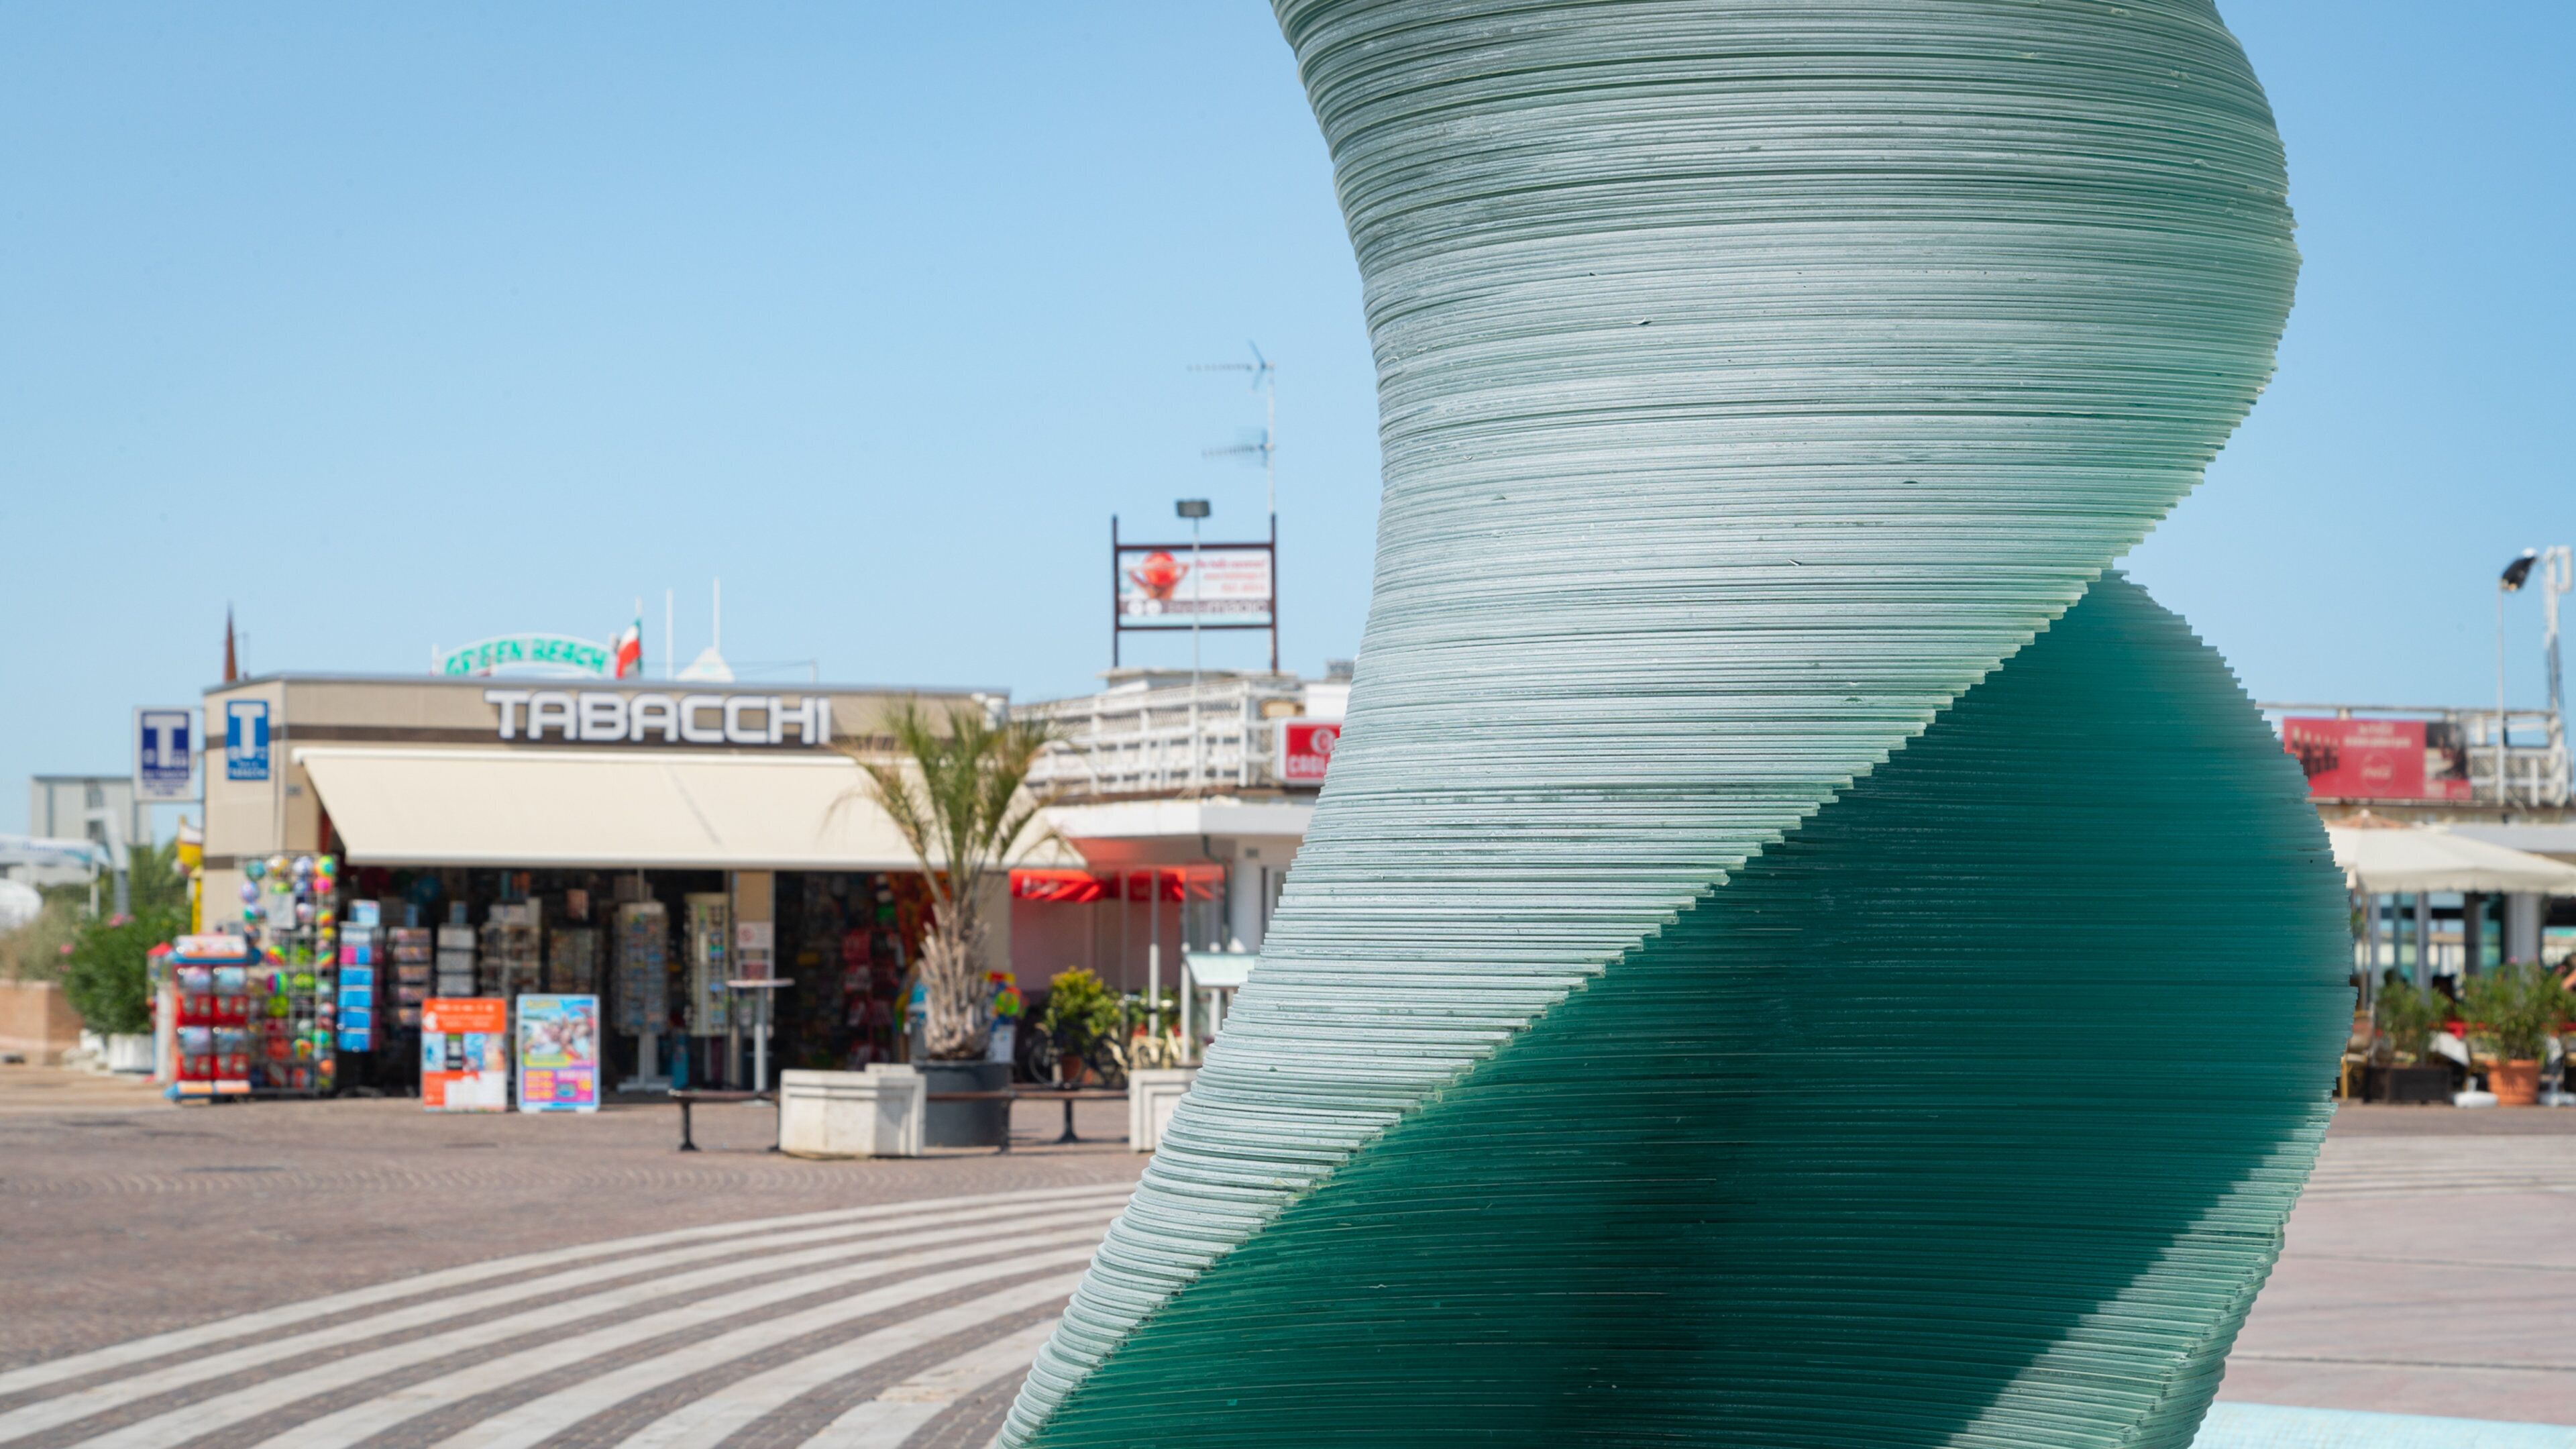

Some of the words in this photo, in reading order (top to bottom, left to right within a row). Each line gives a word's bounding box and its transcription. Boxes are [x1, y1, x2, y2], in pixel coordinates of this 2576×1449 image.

[445, 639, 523, 675] GREEN
[531, 638, 608, 674] BEACH
[144, 715, 186, 767] T
[230, 704, 266, 759] T
[484, 690, 831, 744] TABACCHI
